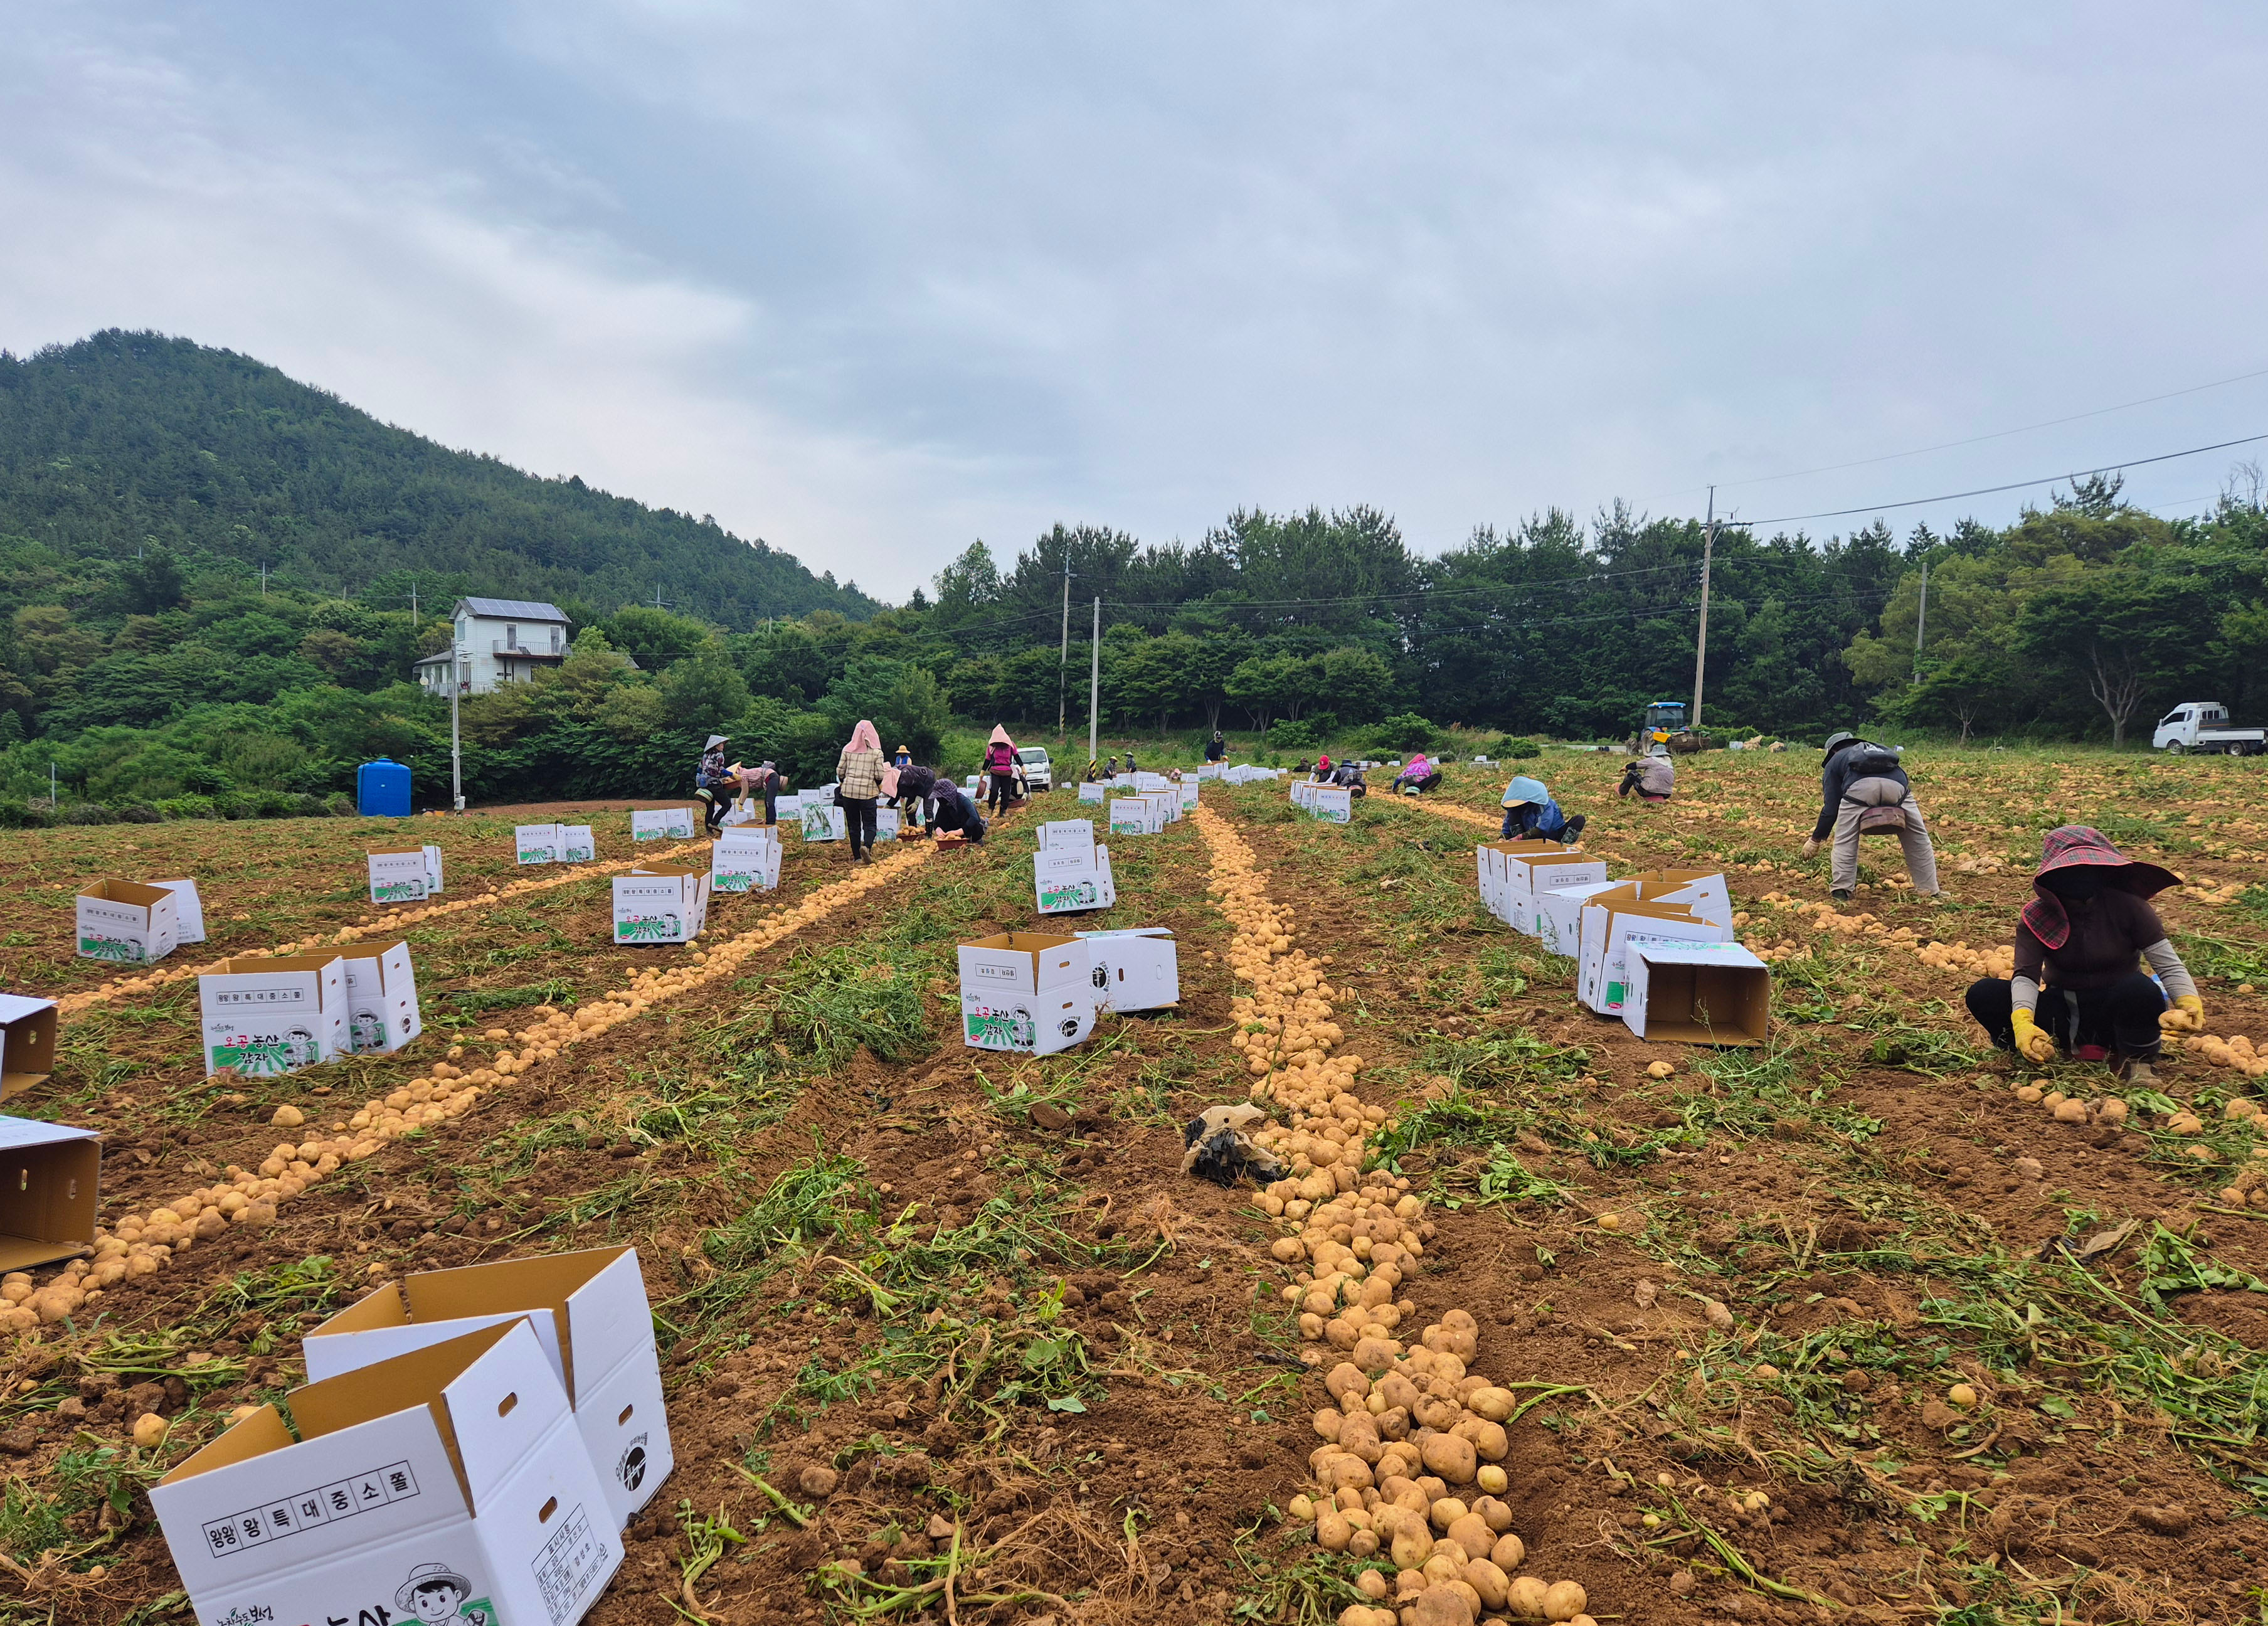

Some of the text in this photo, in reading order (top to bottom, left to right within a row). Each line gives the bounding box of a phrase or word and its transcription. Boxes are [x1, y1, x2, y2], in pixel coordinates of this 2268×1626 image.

[1047, 885, 1075, 894] 오공 농산
[625, 915, 657, 924] 오공 농산
[88, 933, 122, 945] 오공 농산
[218, 994, 228, 1002] 왕왕
[974, 1006, 1009, 1022] 오공 농산
[984, 1023, 1003, 1035] 감자
[223, 1034, 280, 1048] 오공 농산
[239, 1052, 268, 1064] 감자
[209, 1524, 237, 1548] 왕왕
[242, 1517, 261, 1538] 왕
[272, 1508, 290, 1527] 특
[301, 1499, 321, 1518] 대
[330, 1490, 349, 1511] 중
[362, 1482, 380, 1501] 소
